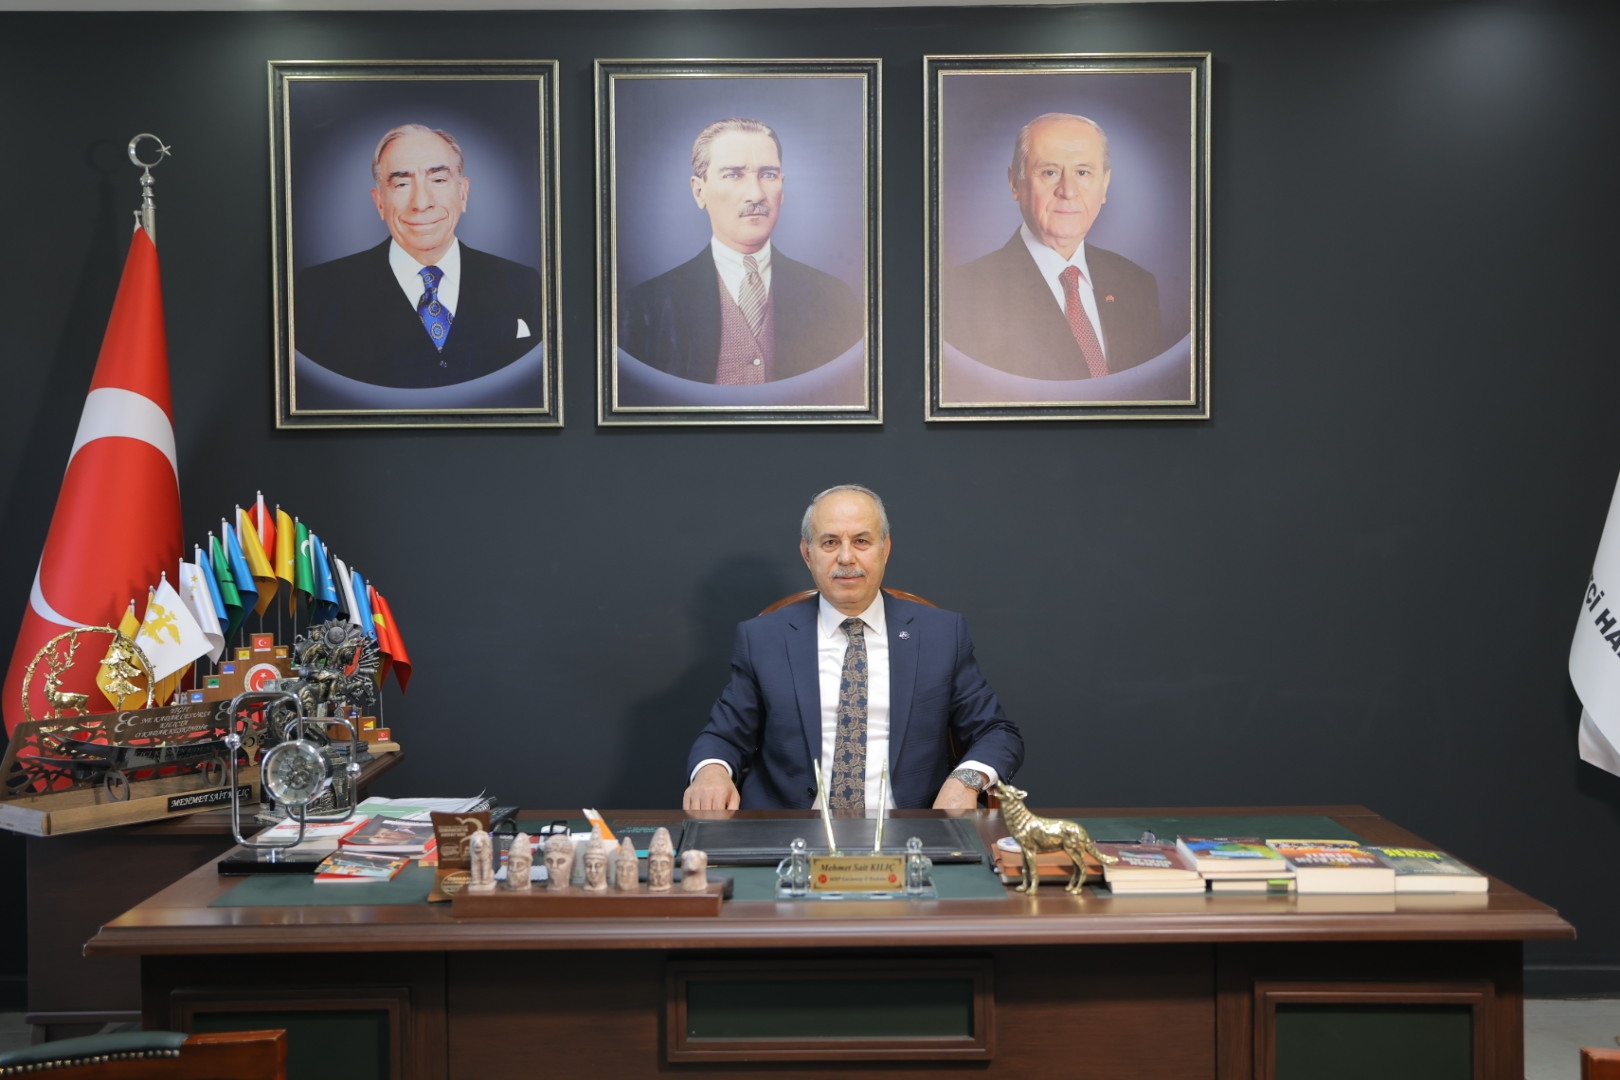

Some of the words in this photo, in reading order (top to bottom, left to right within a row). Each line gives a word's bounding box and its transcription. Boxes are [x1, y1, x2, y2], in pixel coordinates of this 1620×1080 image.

[1595, 608, 1620, 658] HA
[171, 795, 208, 807] MEHMET
[228, 788, 249, 799] KLIÇ
[821, 863, 851, 871] Mehmet
